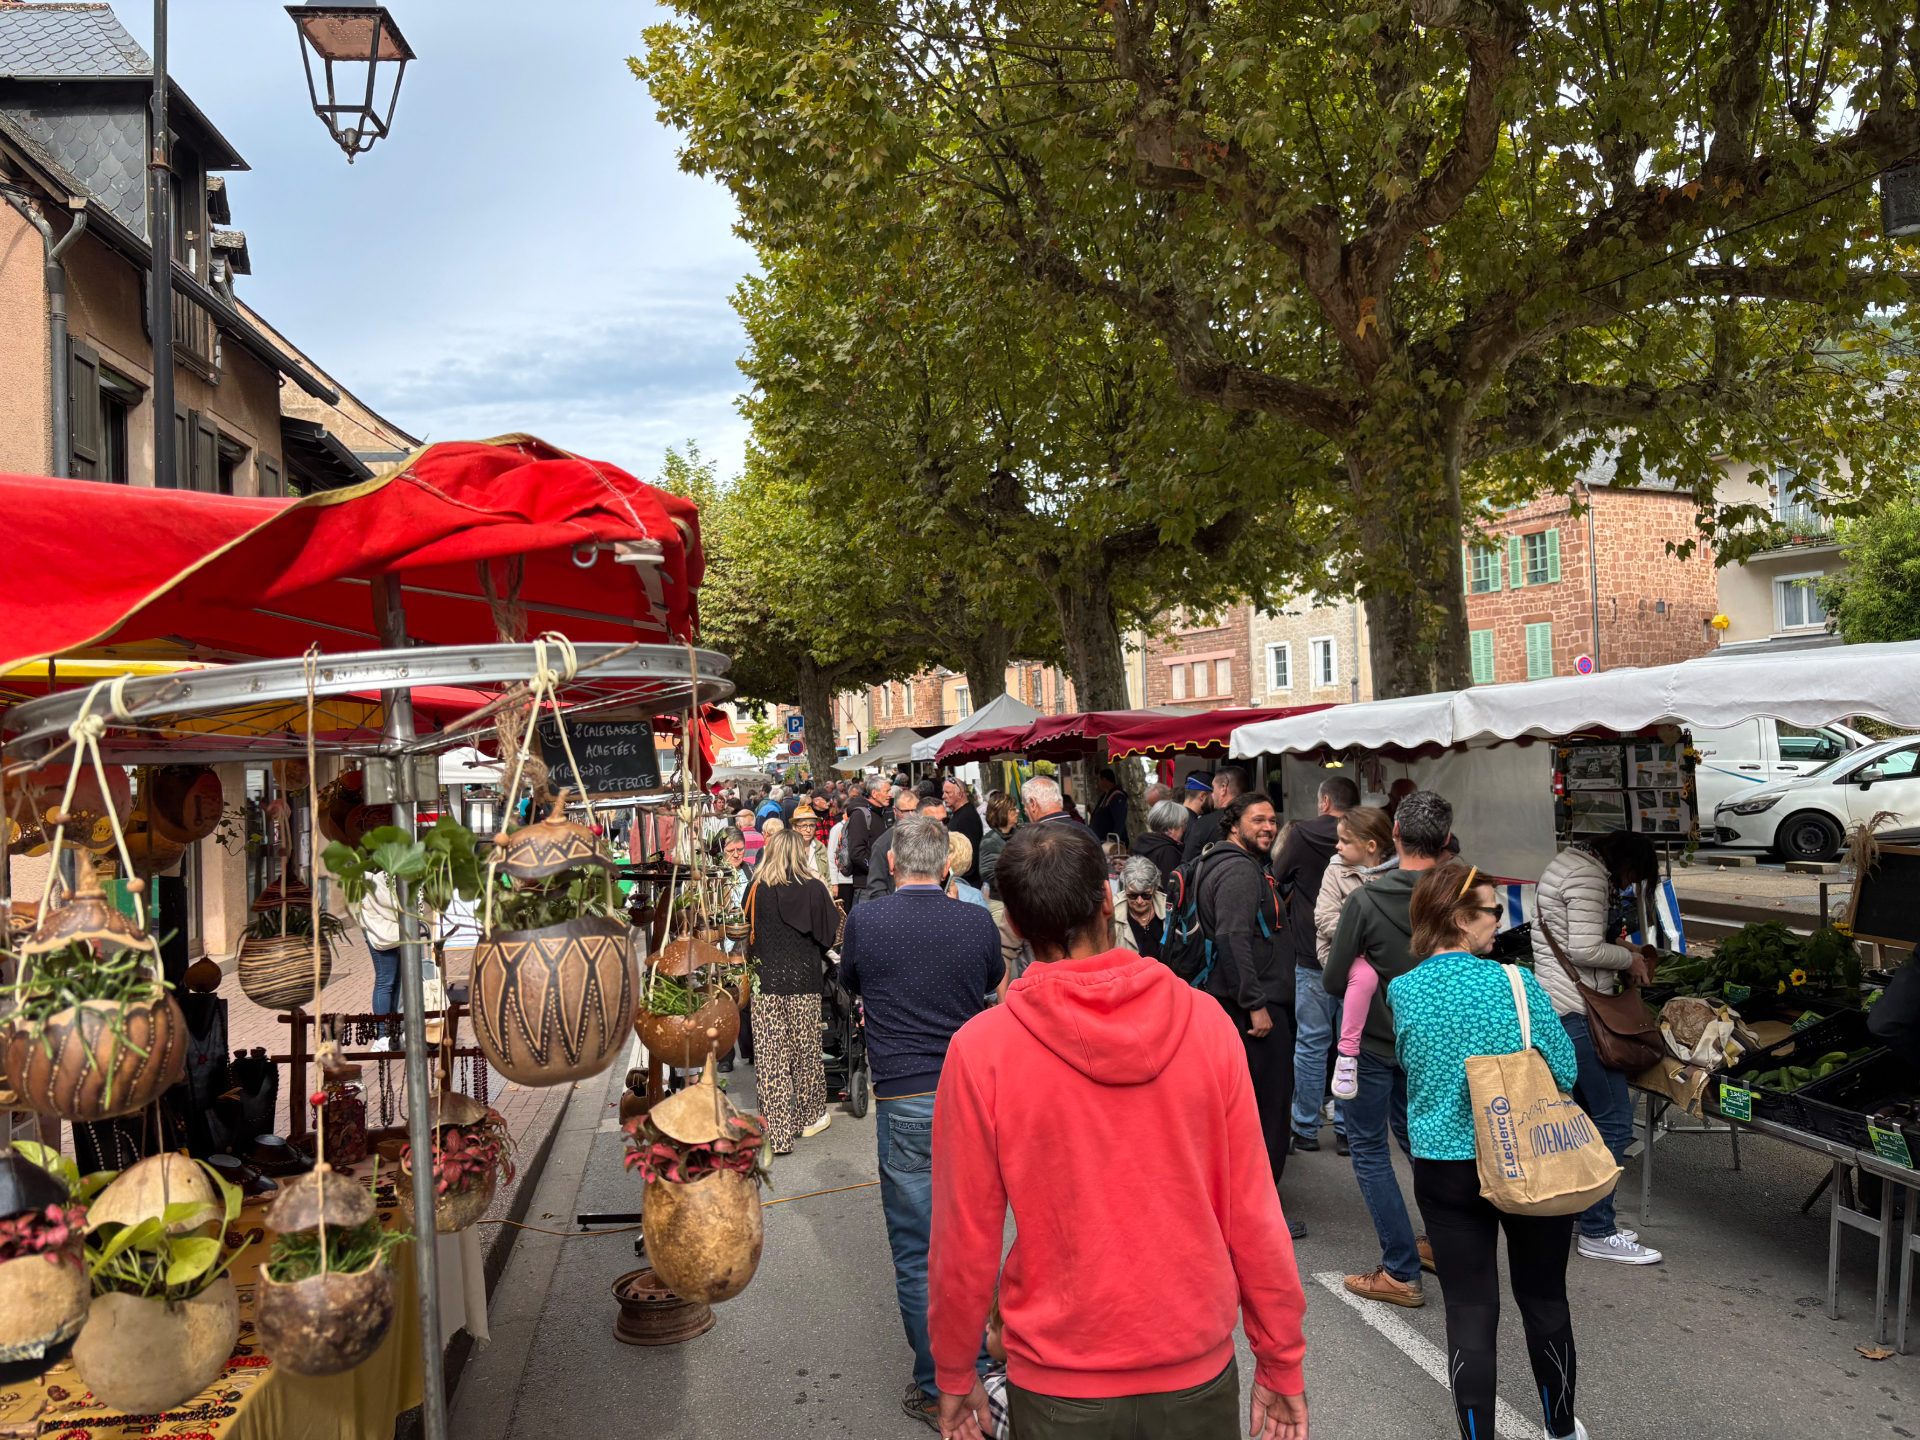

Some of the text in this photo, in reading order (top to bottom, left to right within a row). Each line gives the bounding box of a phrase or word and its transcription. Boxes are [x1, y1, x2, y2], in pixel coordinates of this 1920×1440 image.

[584, 723, 648, 737] CALEBASSES
[792, 719, 800, 730] P
[586, 741, 637, 758] ACHETÉES
[598, 774, 655, 792] OFFERTE
[1497, 1117, 1518, 1178] E.Leclerc
